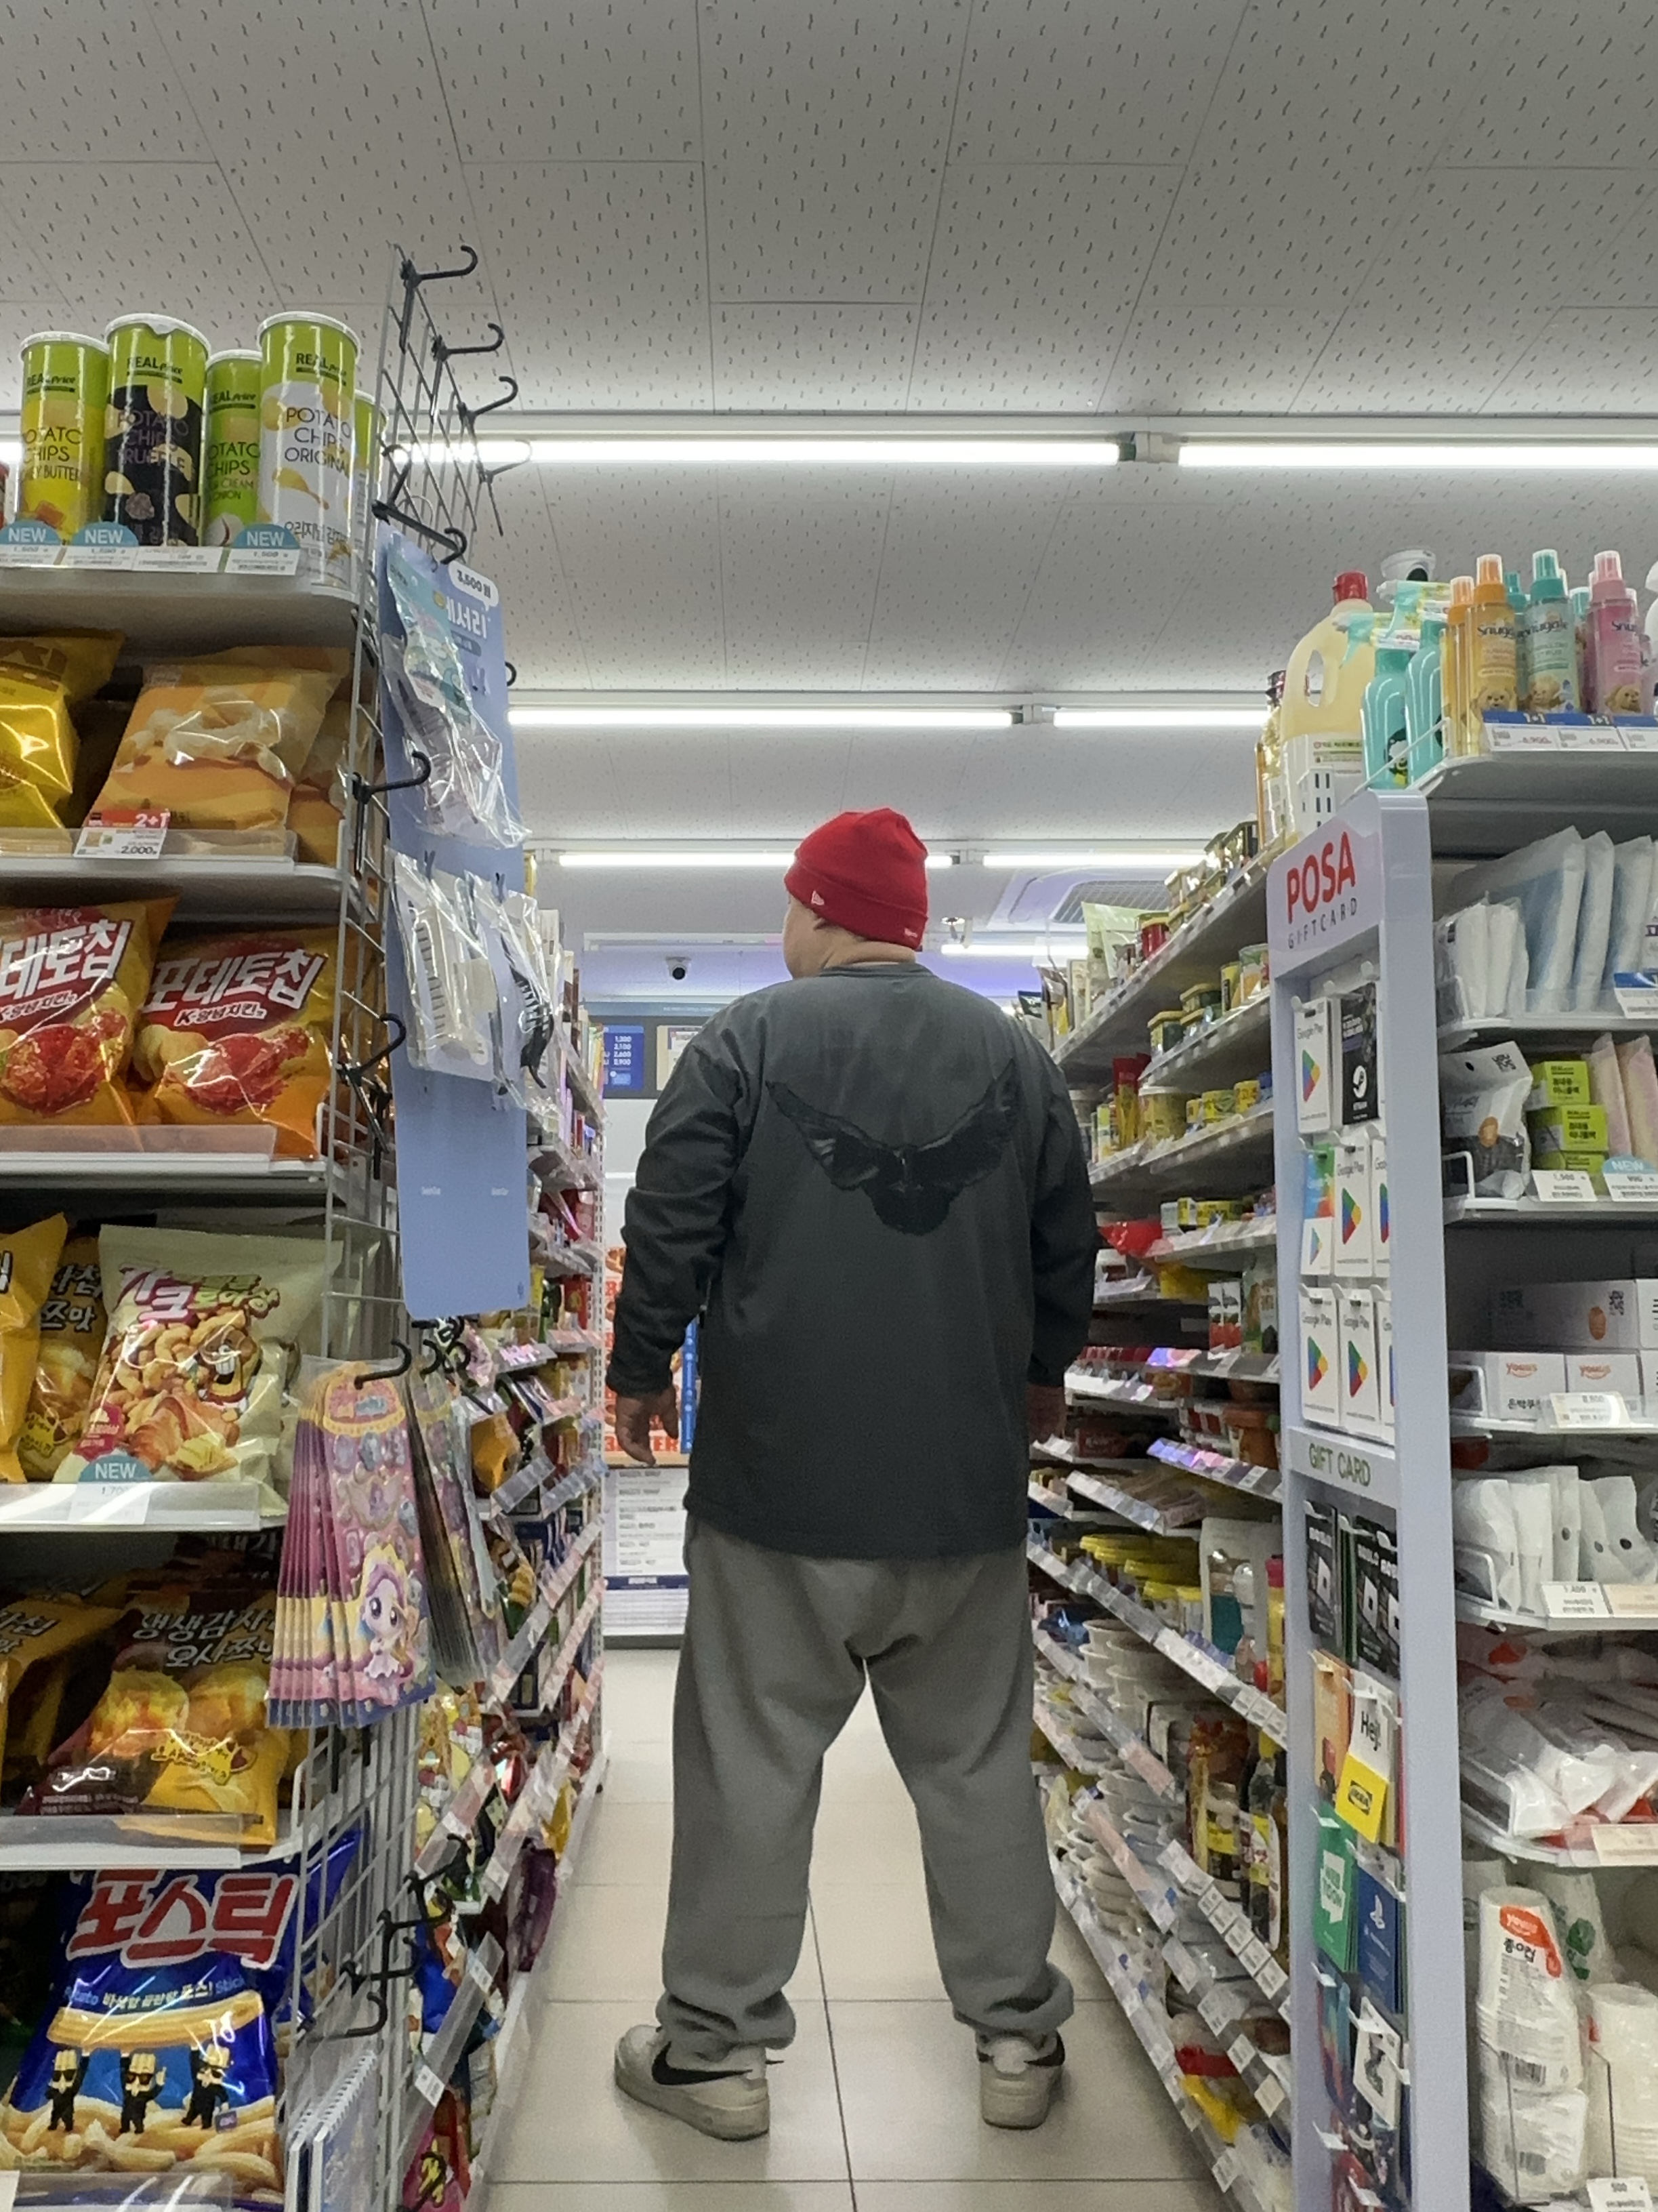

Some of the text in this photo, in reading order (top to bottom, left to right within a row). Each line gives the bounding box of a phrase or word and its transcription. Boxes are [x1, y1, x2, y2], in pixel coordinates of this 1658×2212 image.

[287, 407, 352, 439] POTATO
[9, 527, 46, 543] NEW
[85, 529, 123, 544] NEW
[247, 531, 285, 548] NEW
[1523, 712, 1546, 724] 1+1
[1588, 715, 1611, 725] 1+1
[135, 813, 171, 828] 2+1
[1286, 831, 1356, 925] POSA
[1287, 897, 1358, 949] GIFTCARD
[0, 918, 132, 1000] 테토칩
[1611, 1160, 1644, 1171] NEW
[95, 1462, 138, 1479] NEW
[1308, 1442, 1371, 1487] GIFT CARD
[133, 1609, 275, 1642] 생생감자
[64, 1868, 300, 1971] 포스틱
